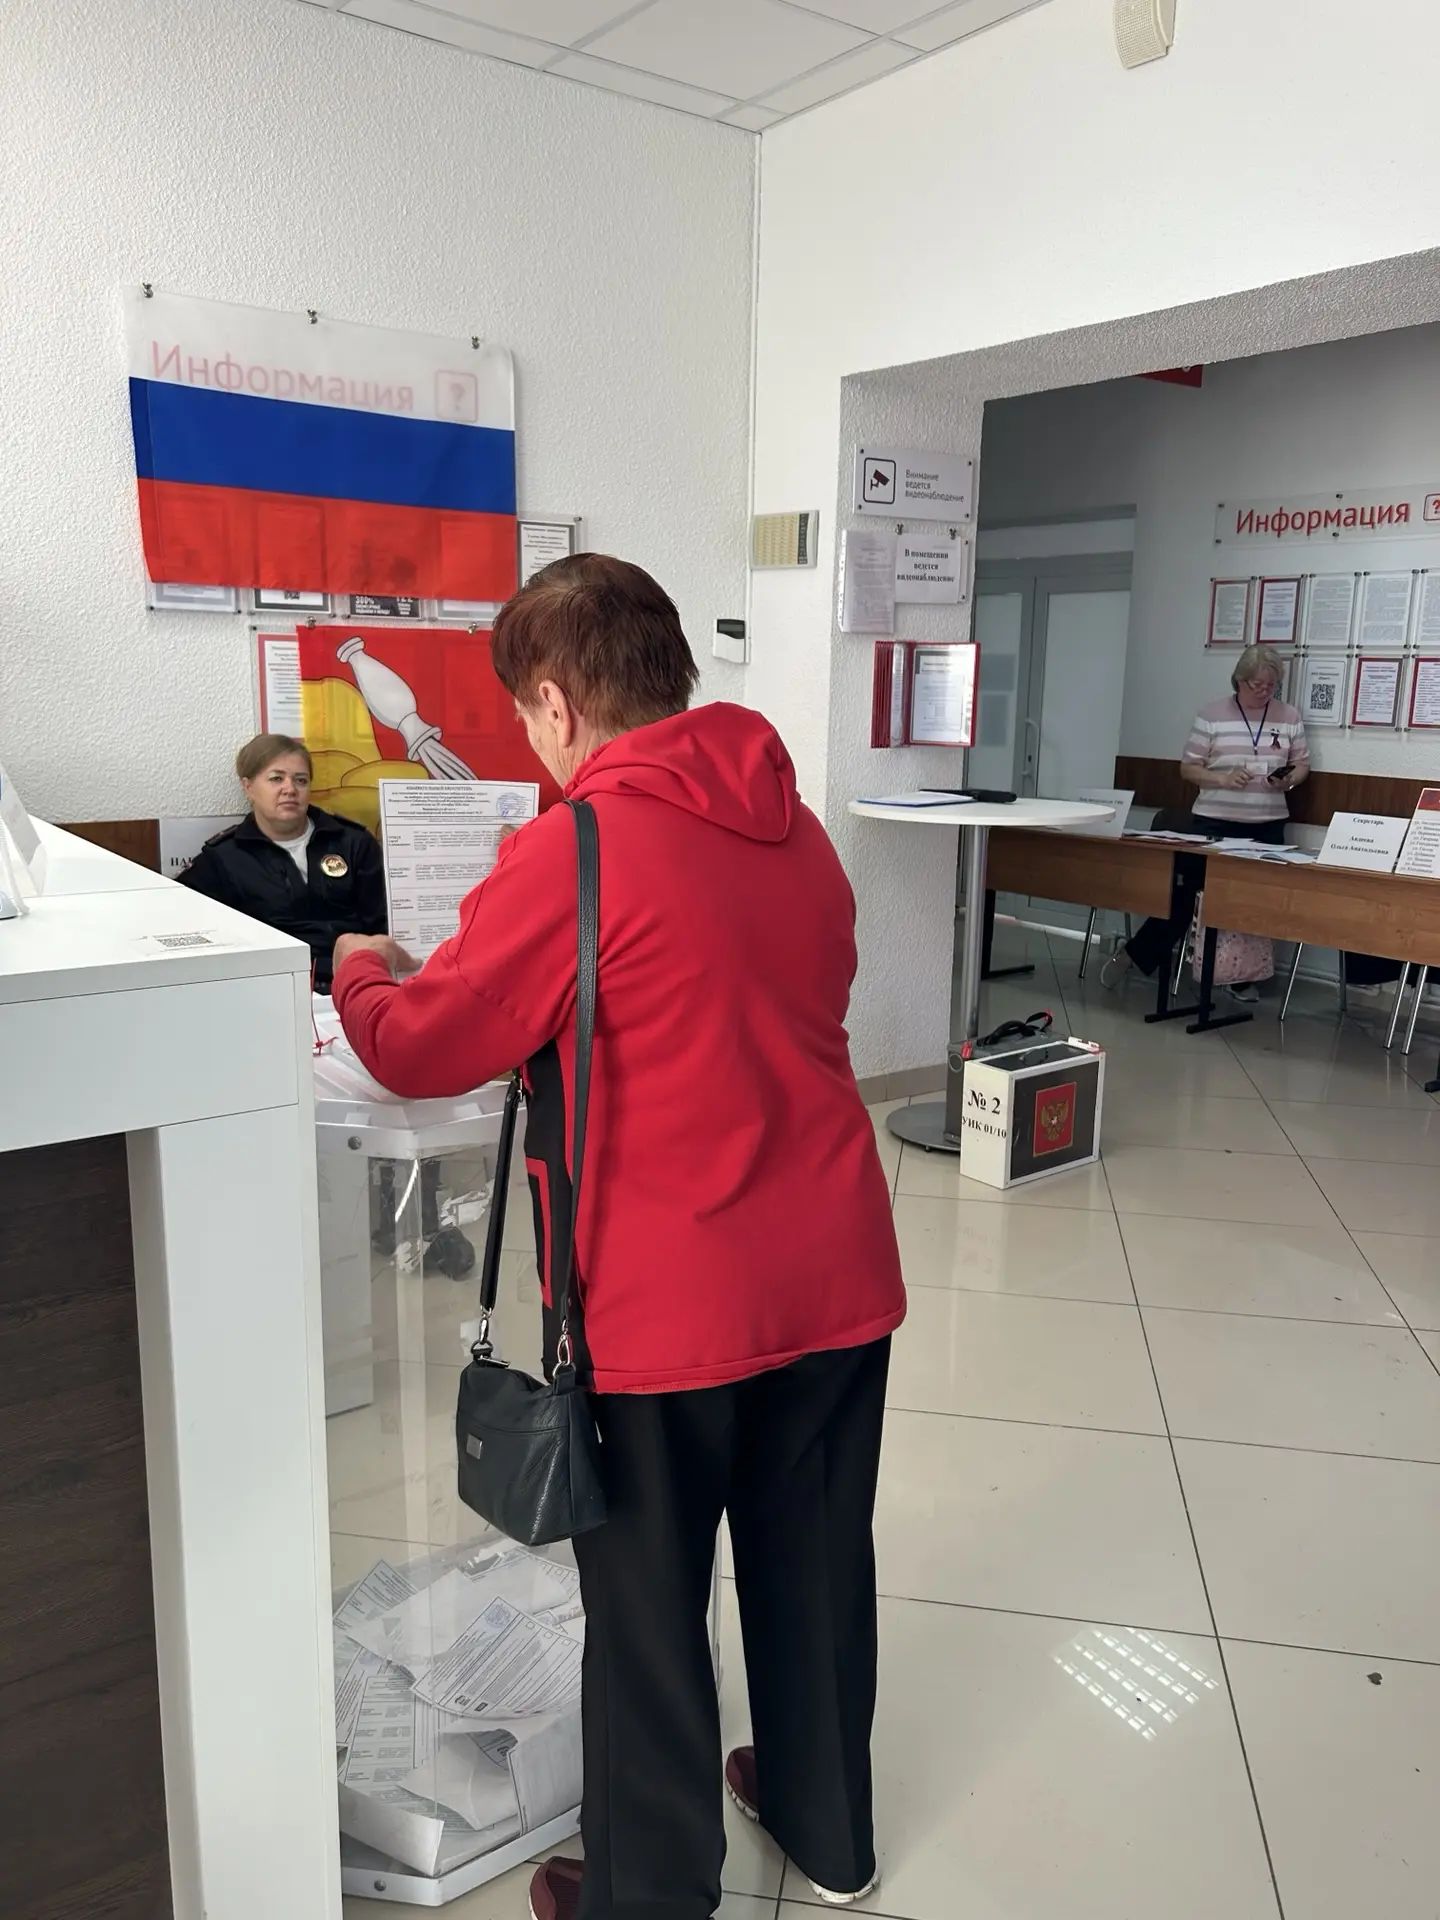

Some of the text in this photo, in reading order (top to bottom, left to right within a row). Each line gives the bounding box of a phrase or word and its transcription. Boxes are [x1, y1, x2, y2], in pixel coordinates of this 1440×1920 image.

[905, 469, 939, 482] Внимание
[905, 481, 931, 490] ведется
[905, 489, 965, 503] видеонаблюдение
[1236, 503, 1410, 538] Информация
[904, 548, 949, 559] В помещении
[896, 574, 955, 583] видеонаблюдение
[1352, 817, 1384, 827] Секретарь
[968, 1088, 1001, 1115] № 2
[962, 1115, 1007, 1139] УИК 01/10
